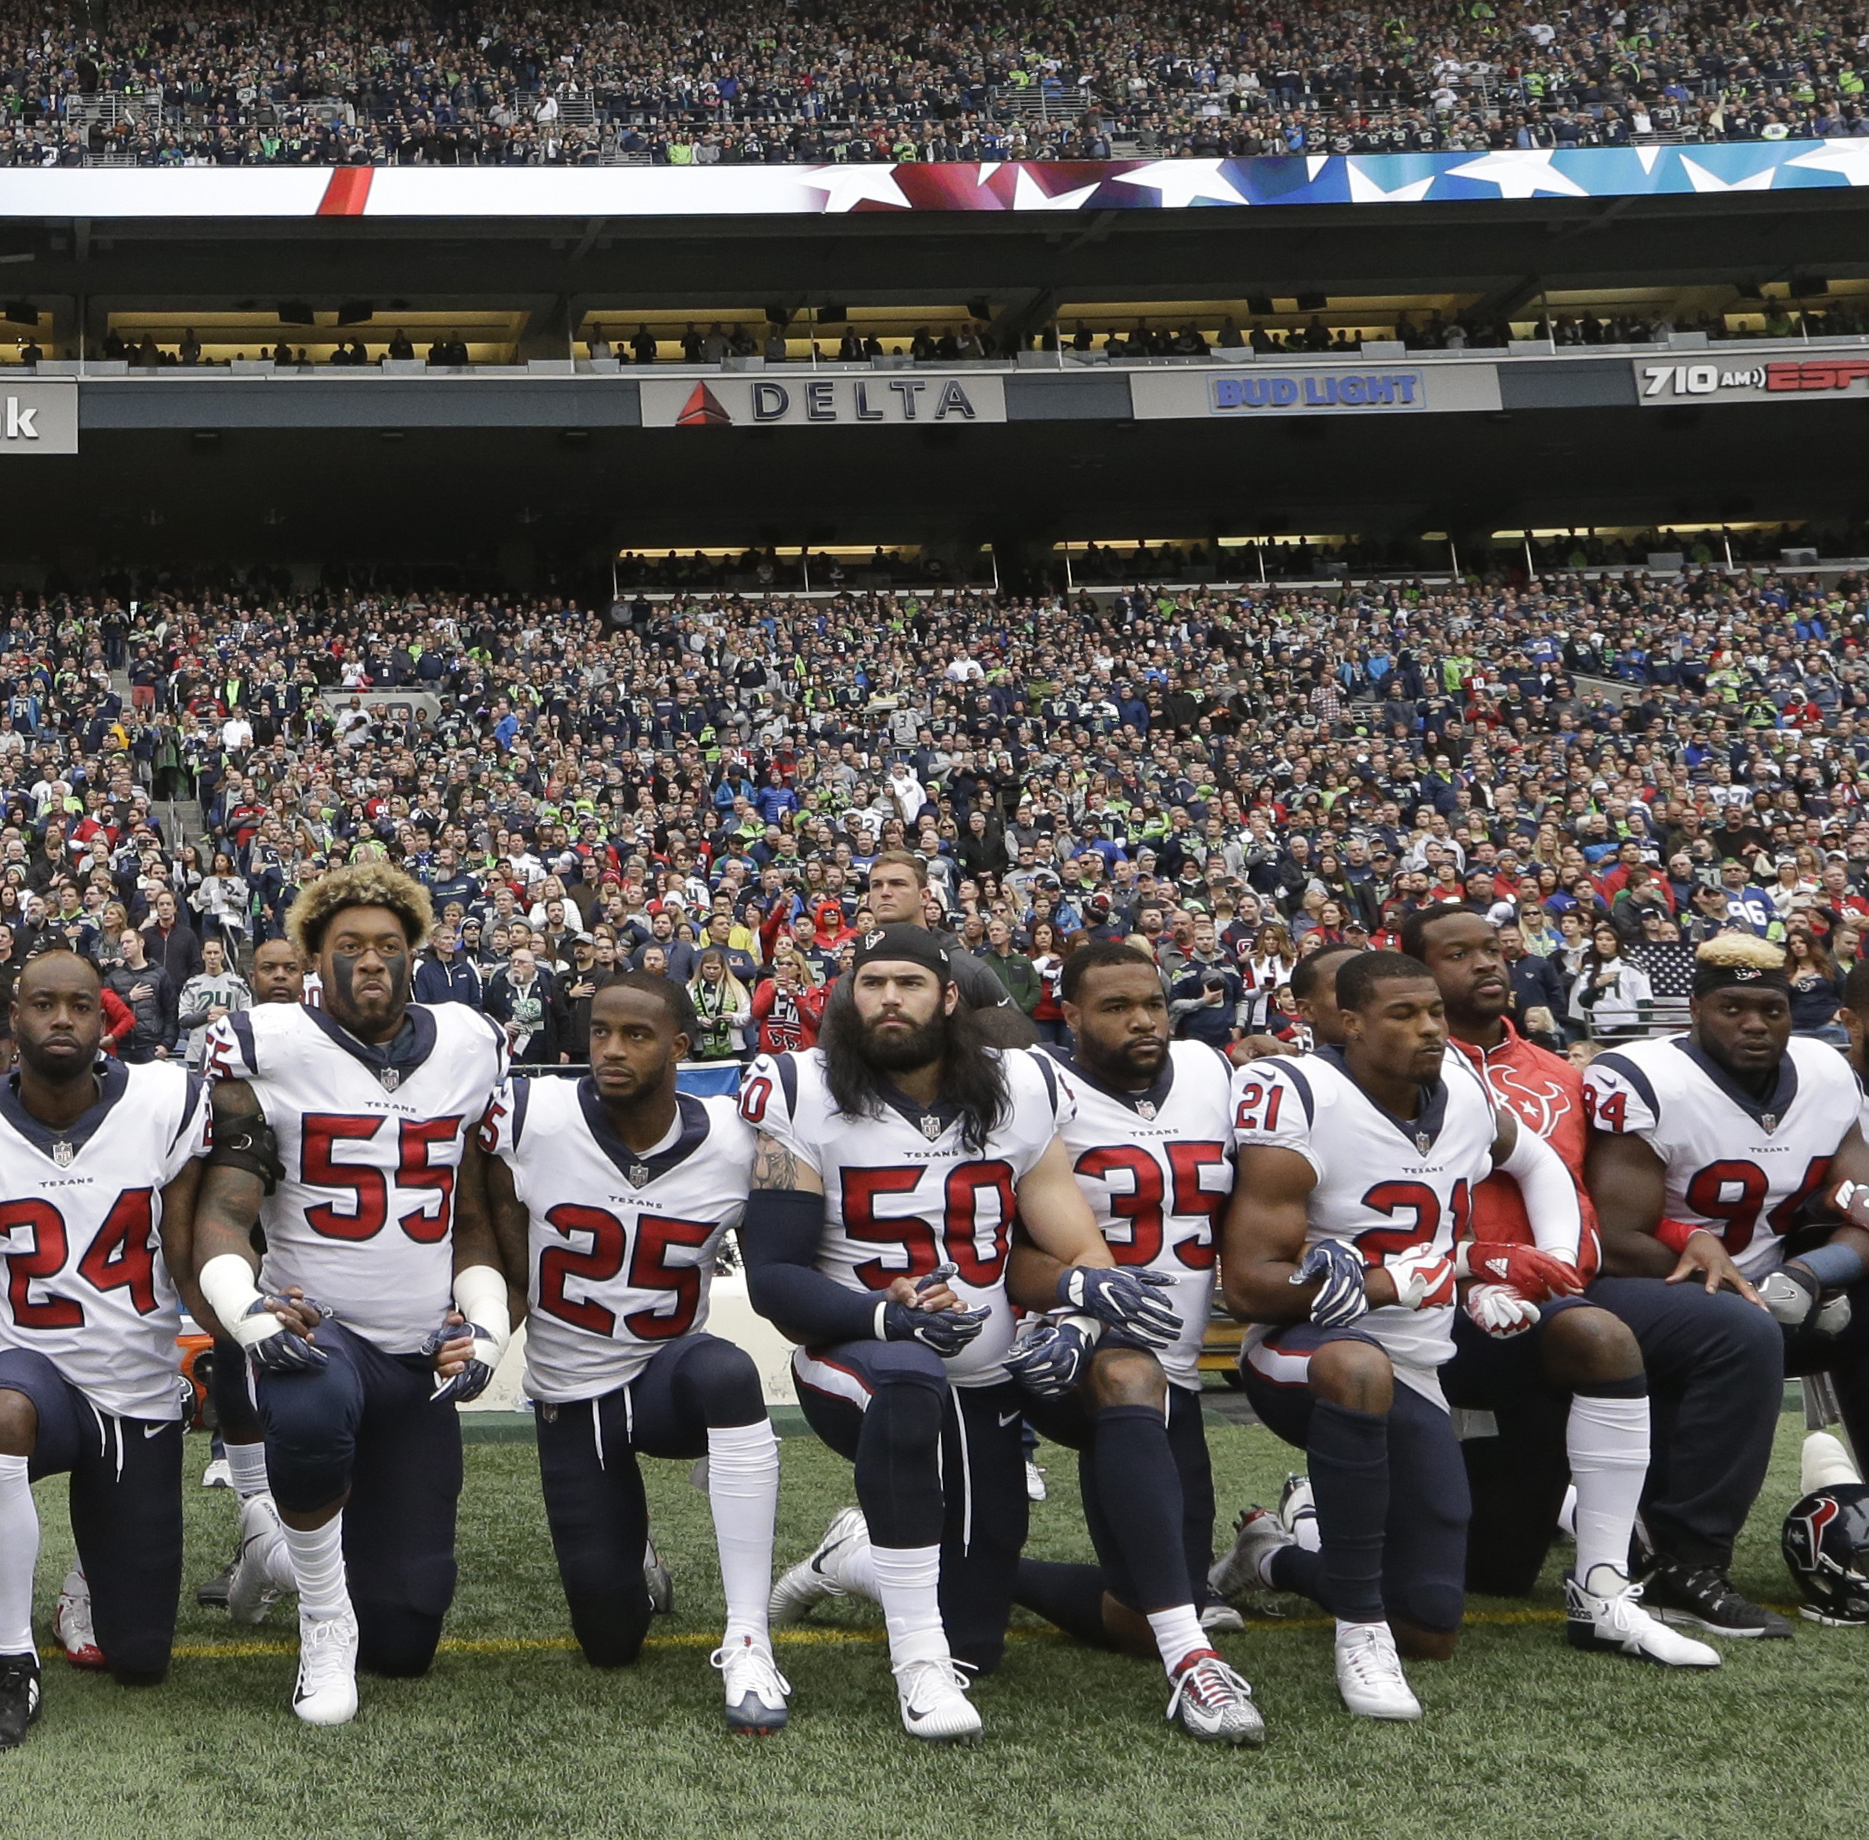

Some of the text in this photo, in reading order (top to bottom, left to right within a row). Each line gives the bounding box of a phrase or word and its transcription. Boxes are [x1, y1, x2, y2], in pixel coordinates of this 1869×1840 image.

[1216, 375, 1418, 408] BUD LIGHT
[1644, 365, 1719, 396] 710
[1721, 371, 1752, 388] AM
[751, 380, 977, 422] DELTA
[1471, 677, 1486, 691] 10
[1051, 701, 1069, 717] 12
[1726, 900, 1767, 927] 96
[365, 1101, 417, 1113] TEXANS
[1235, 1082, 1282, 1132] 21
[1128, 1128, 1180, 1139] TEXANS
[903, 1151, 959, 1159] TEXANS
[1749, 1146, 1791, 1155] TEXANS
[39, 1176, 94, 1188] TEXANS
[299, 1112, 466, 1243] 55
[1401, 1165, 1445, 1176] TEXANS
[608, 1195, 663, 1209] TEXANS
[1072, 1140, 1234, 1271] 35
[1685, 1155, 1834, 1257] 94
[839, 1159, 1017, 1290] 50
[1351, 1177, 1469, 1268] 21
[538, 1202, 722, 1342] 25
